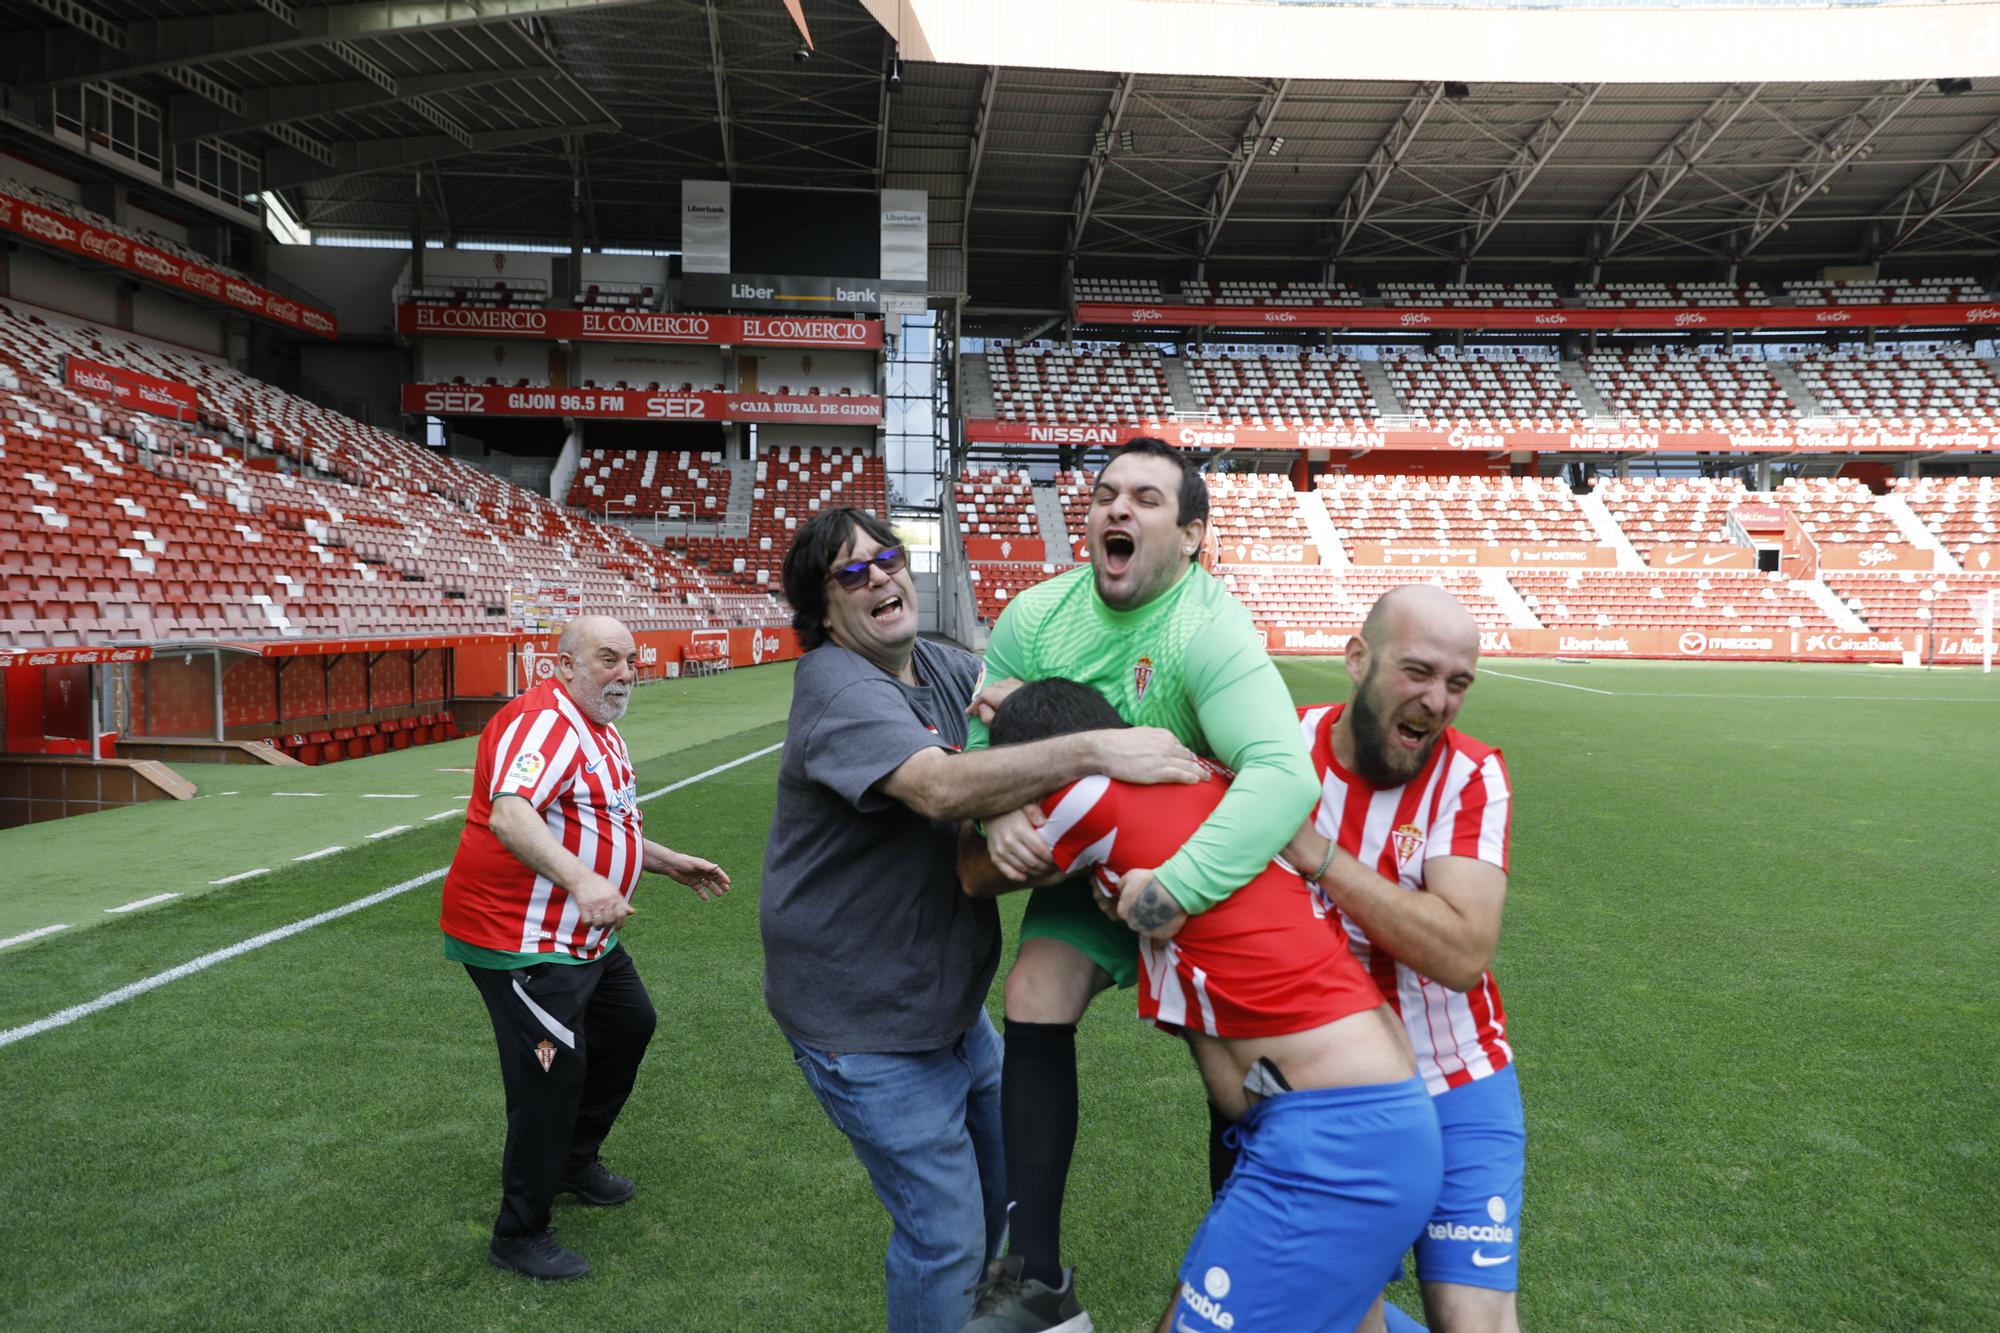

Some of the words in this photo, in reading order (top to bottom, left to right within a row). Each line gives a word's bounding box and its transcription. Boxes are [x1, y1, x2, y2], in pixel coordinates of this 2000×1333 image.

[731, 283, 774, 299] Liber
[836, 287, 876, 303] bank
[417, 309, 440, 325] EL
[443, 310, 547, 330] COMERCIO
[583, 315, 606, 331] EL
[608, 316, 709, 335] COMERCIO
[743, 320, 765, 337] EL
[768, 321, 867, 340] COMERCIO
[425, 392, 485, 413] SER
[508, 393, 556, 409] GIJON
[560, 395, 595, 411] 96.5
[600, 396, 625, 412] FM
[647, 398, 705, 418] SER
[740, 402, 770, 414] CAJA
[774, 402, 817, 414] RURAL
[820, 403, 838, 415] DE
[1031, 427, 1117, 443] NISSAN
[1298, 432, 1385, 448] NISSAN
[1570, 434, 1659, 449] NISSAN
[1542, 552, 1588, 561] SPORTING
[1559, 637, 1629, 651] Liberbank
[1826, 635, 1904, 652] CaixaBank
[1938, 638, 1958, 655] La
[1427, 1221, 1513, 1244] telecable
